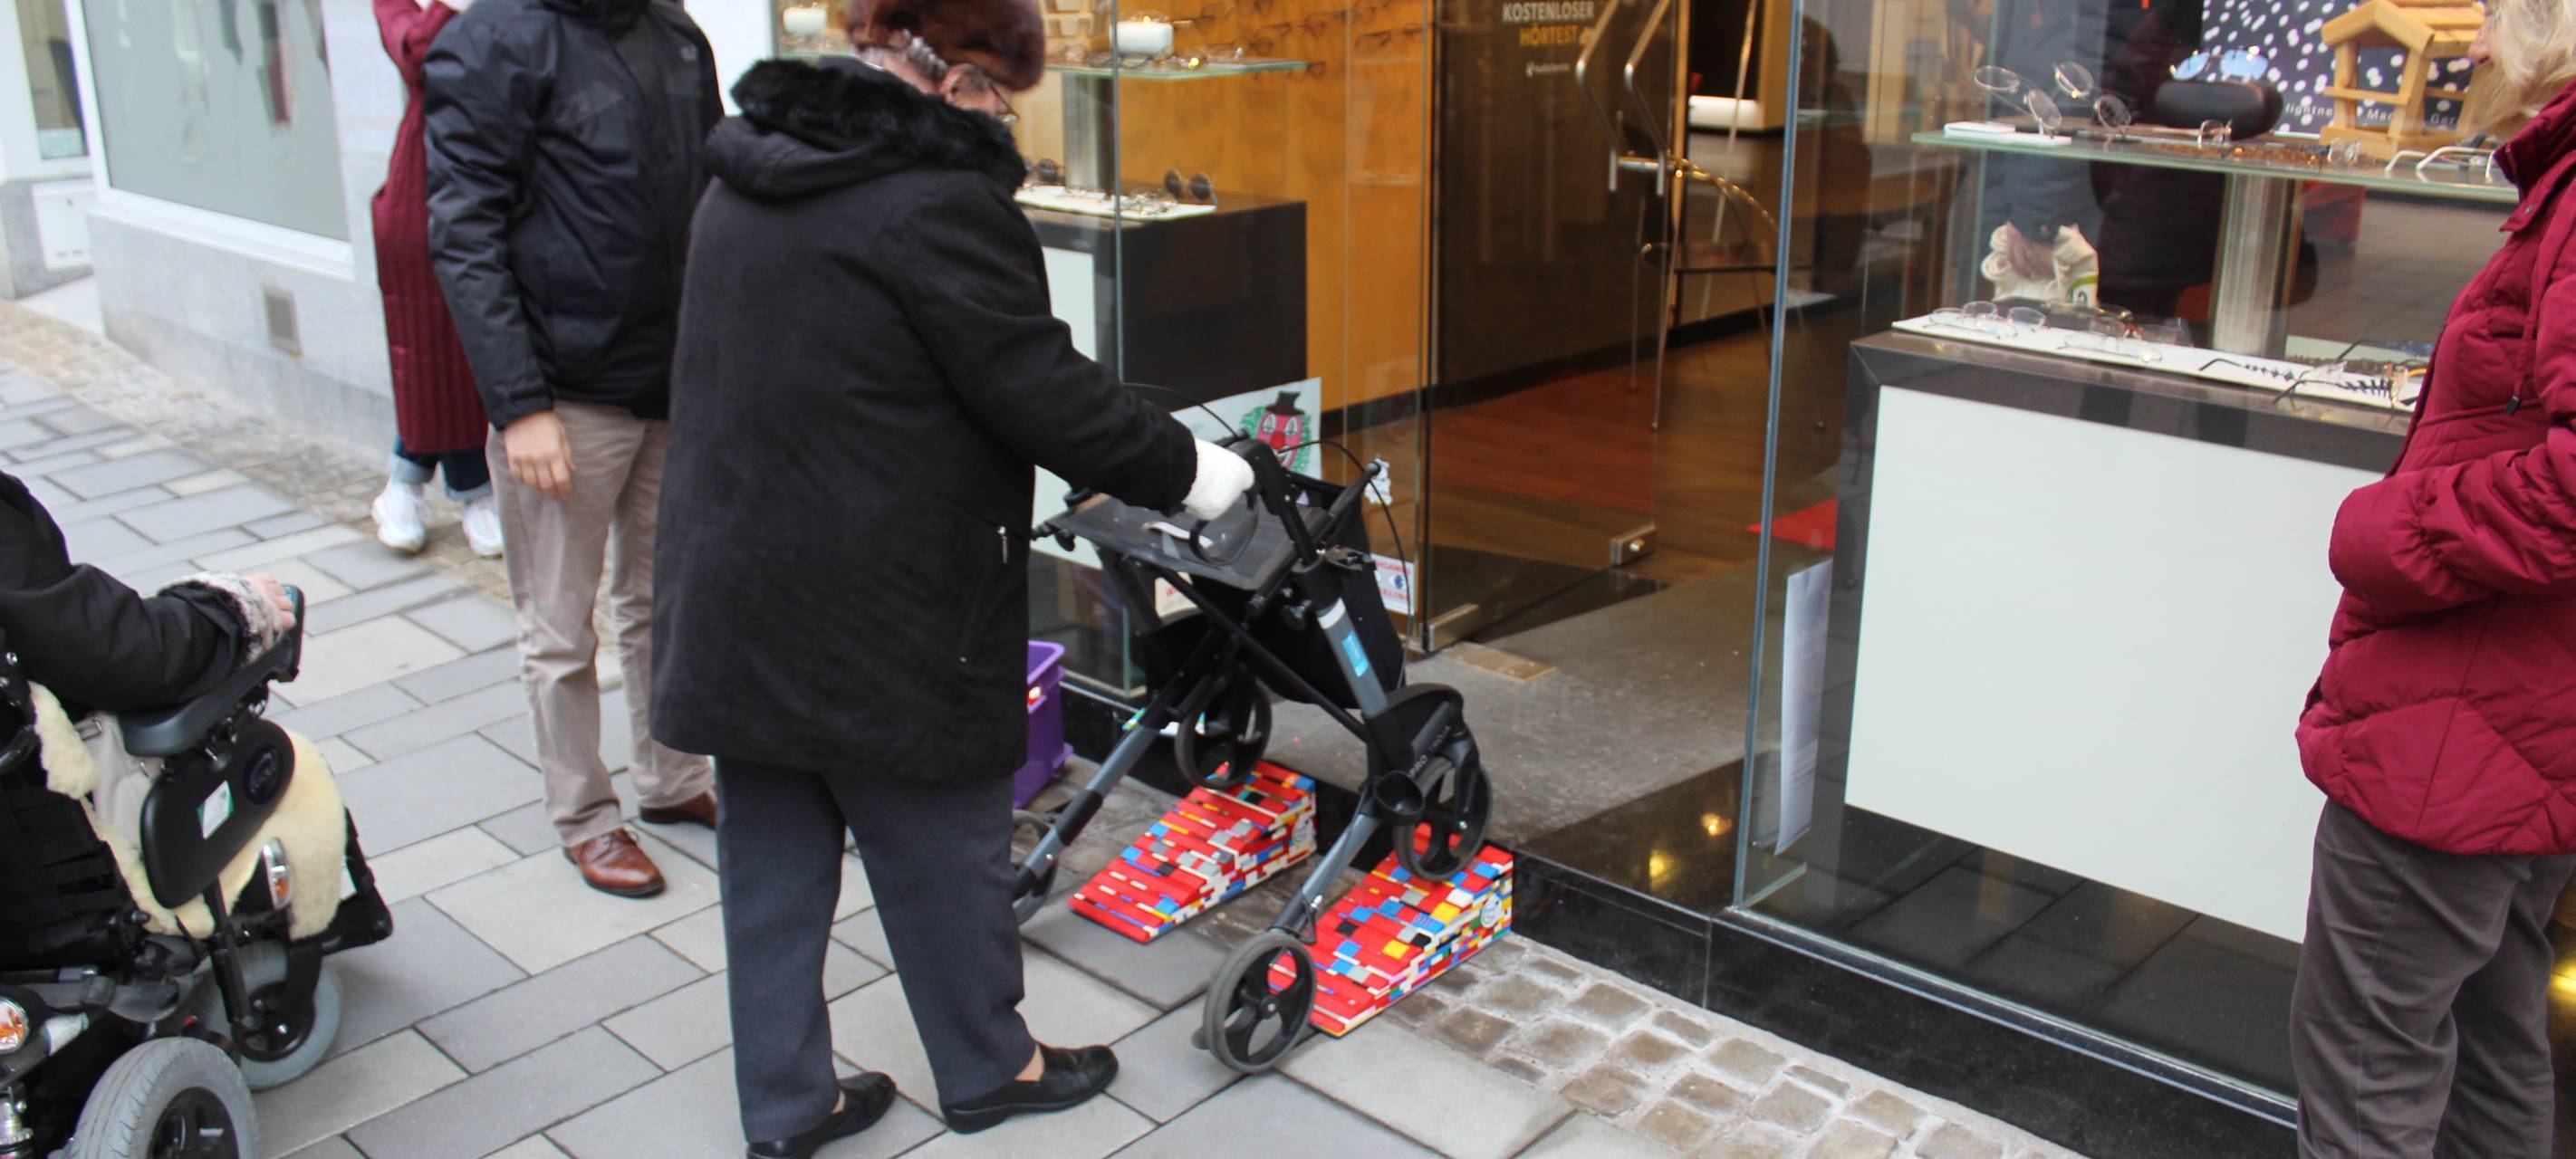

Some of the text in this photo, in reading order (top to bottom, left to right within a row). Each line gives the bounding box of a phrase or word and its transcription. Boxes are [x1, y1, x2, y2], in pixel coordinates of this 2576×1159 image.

[1503, 1, 1594, 22] KOSTENLOSER
[1520, 23, 1578, 46] HÖRTEST
[2285, 102, 2333, 117] lightne
